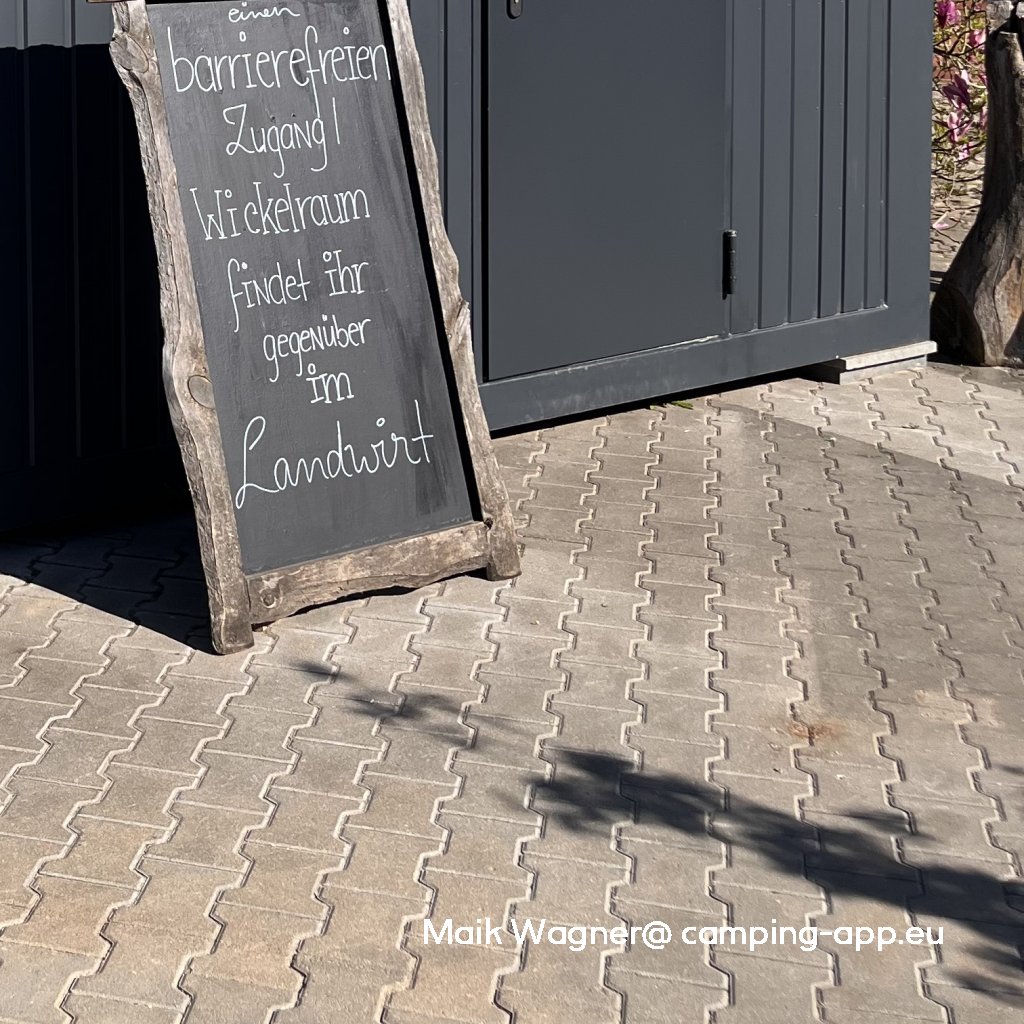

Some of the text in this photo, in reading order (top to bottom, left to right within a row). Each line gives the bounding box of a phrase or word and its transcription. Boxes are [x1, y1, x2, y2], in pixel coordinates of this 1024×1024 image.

[228, 1, 300, 23] einen
[167, 25, 391, 118] barrierefreien
[189, 181, 371, 241] Wickelraum
[322, 249, 369, 296] ihr
[306, 362, 354, 404] im
[235, 399, 434, 510] Landwirt
